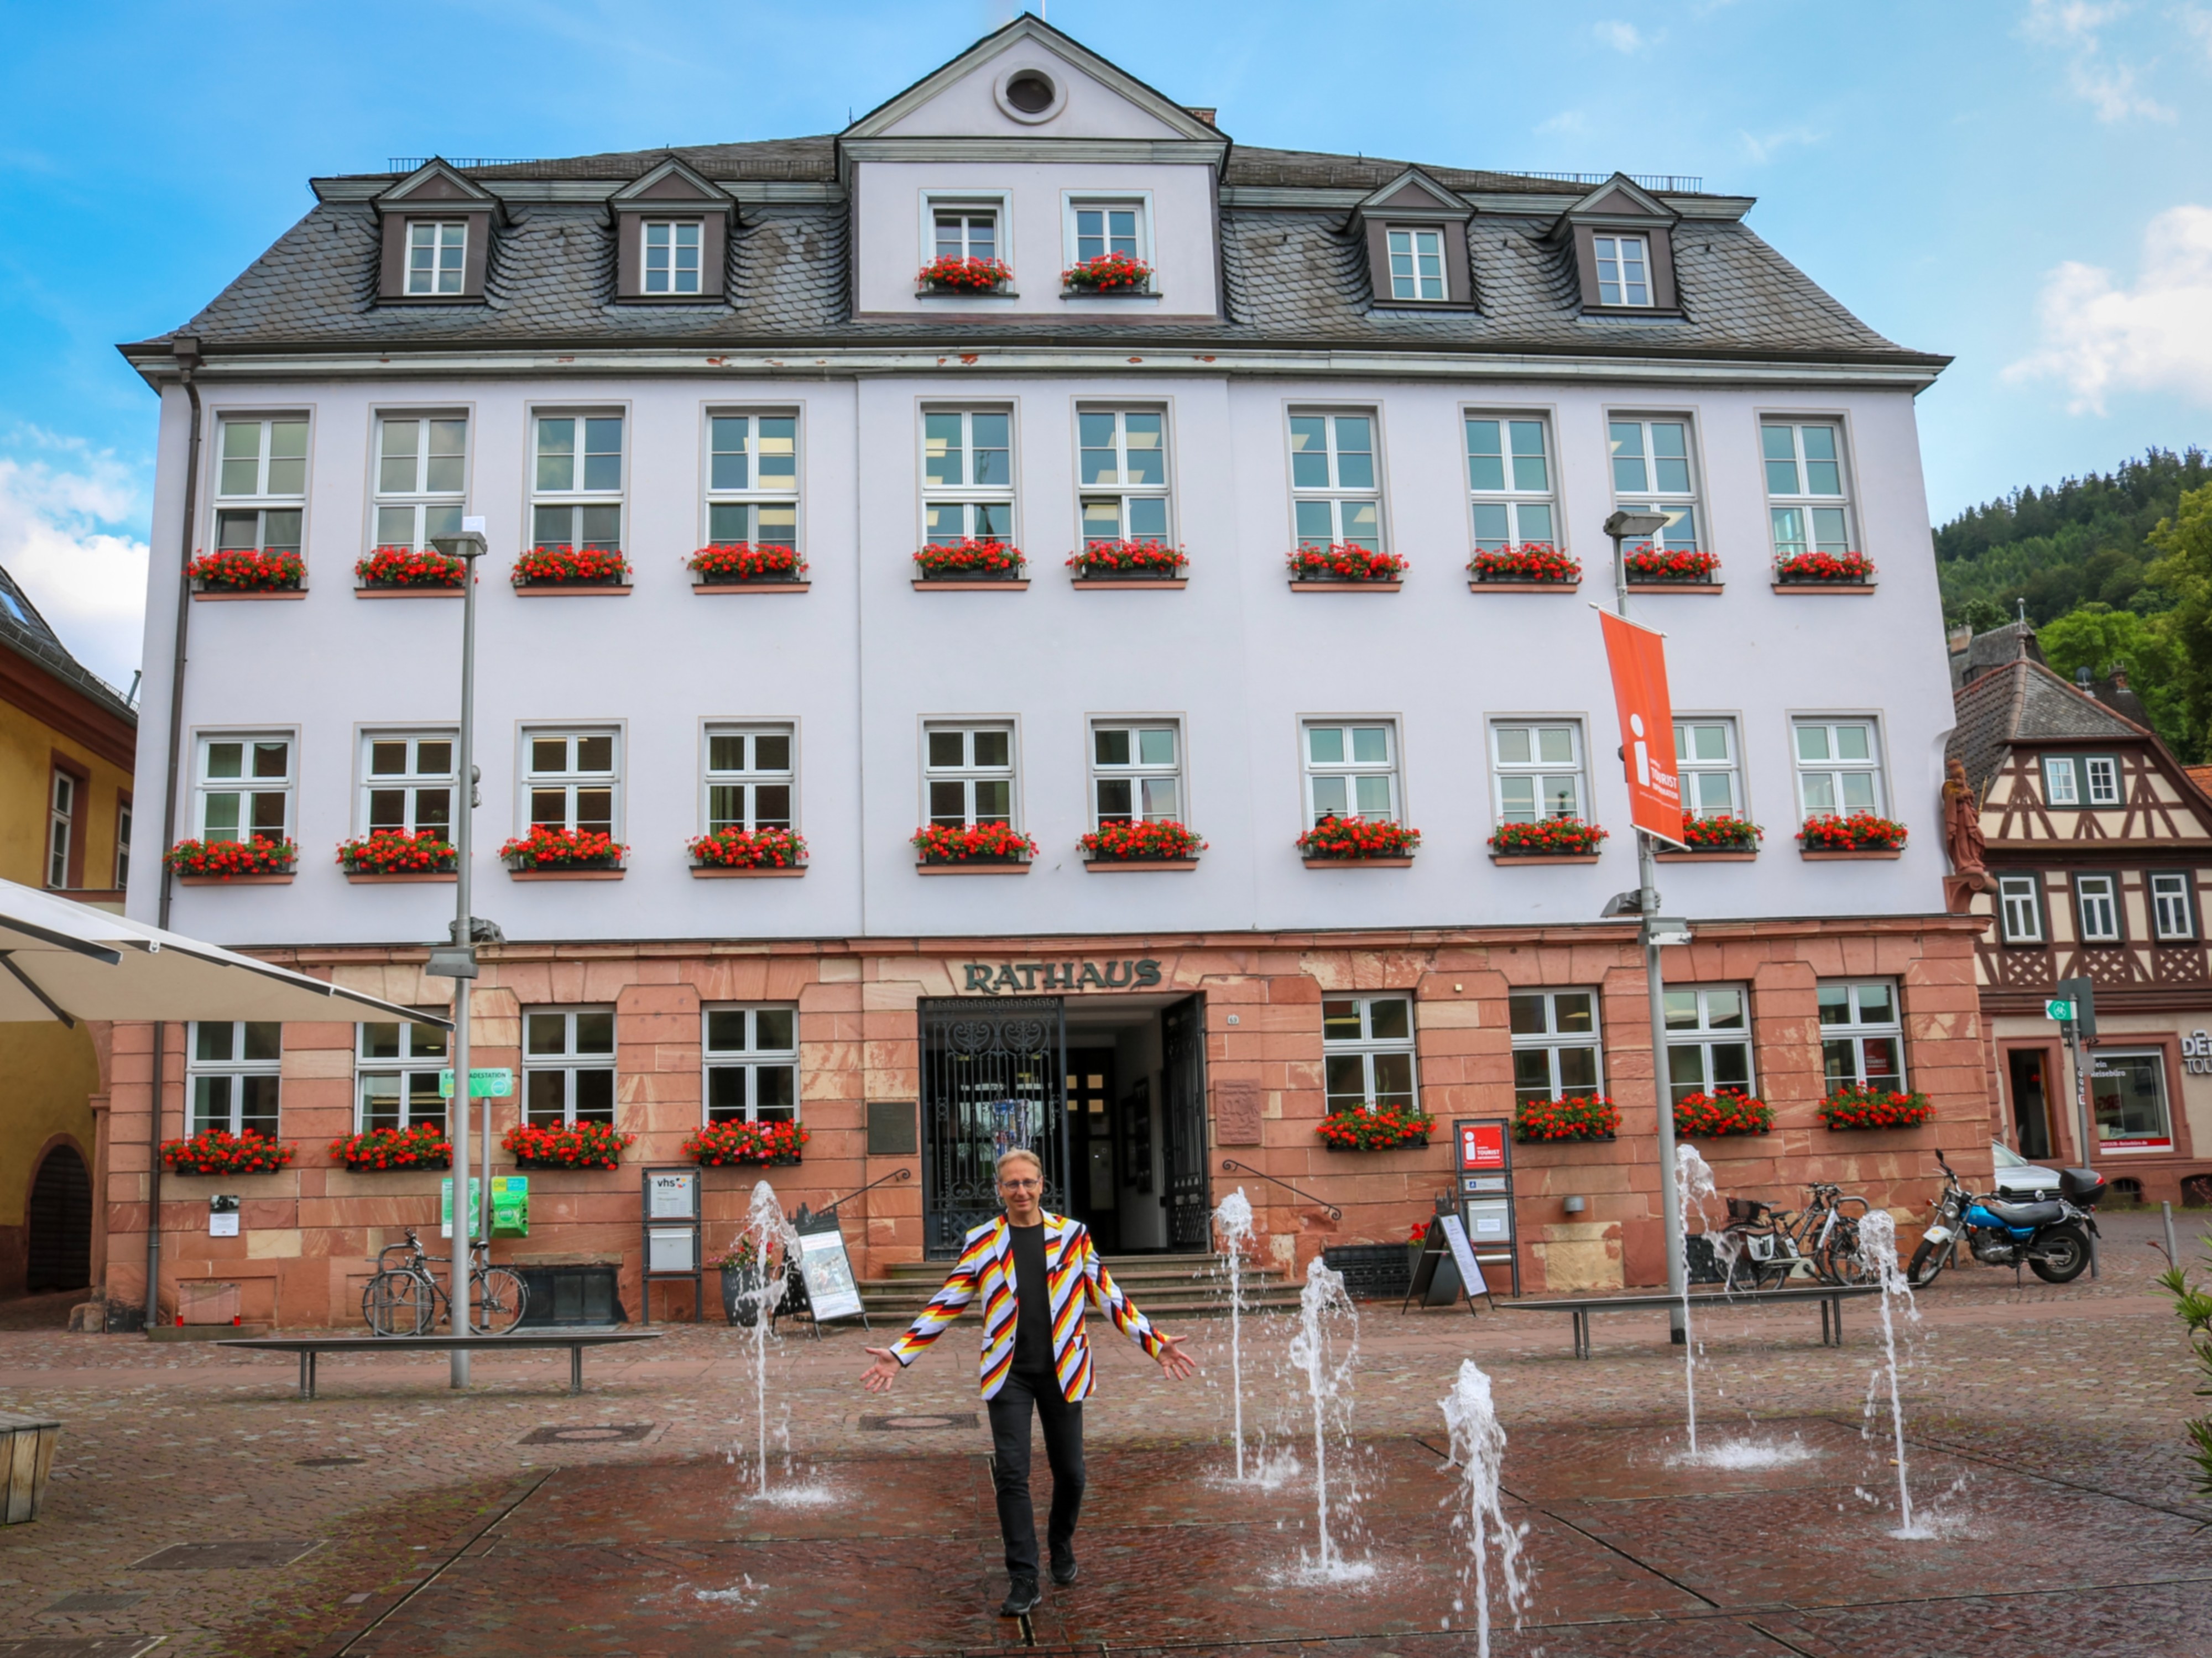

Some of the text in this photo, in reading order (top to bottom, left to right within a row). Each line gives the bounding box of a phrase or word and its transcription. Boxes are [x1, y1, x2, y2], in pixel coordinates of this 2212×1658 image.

[1651, 766, 1677, 789] TOURIST
[964, 959, 1161, 995] RATHAUS
[658, 1178, 675, 1187] vhs
